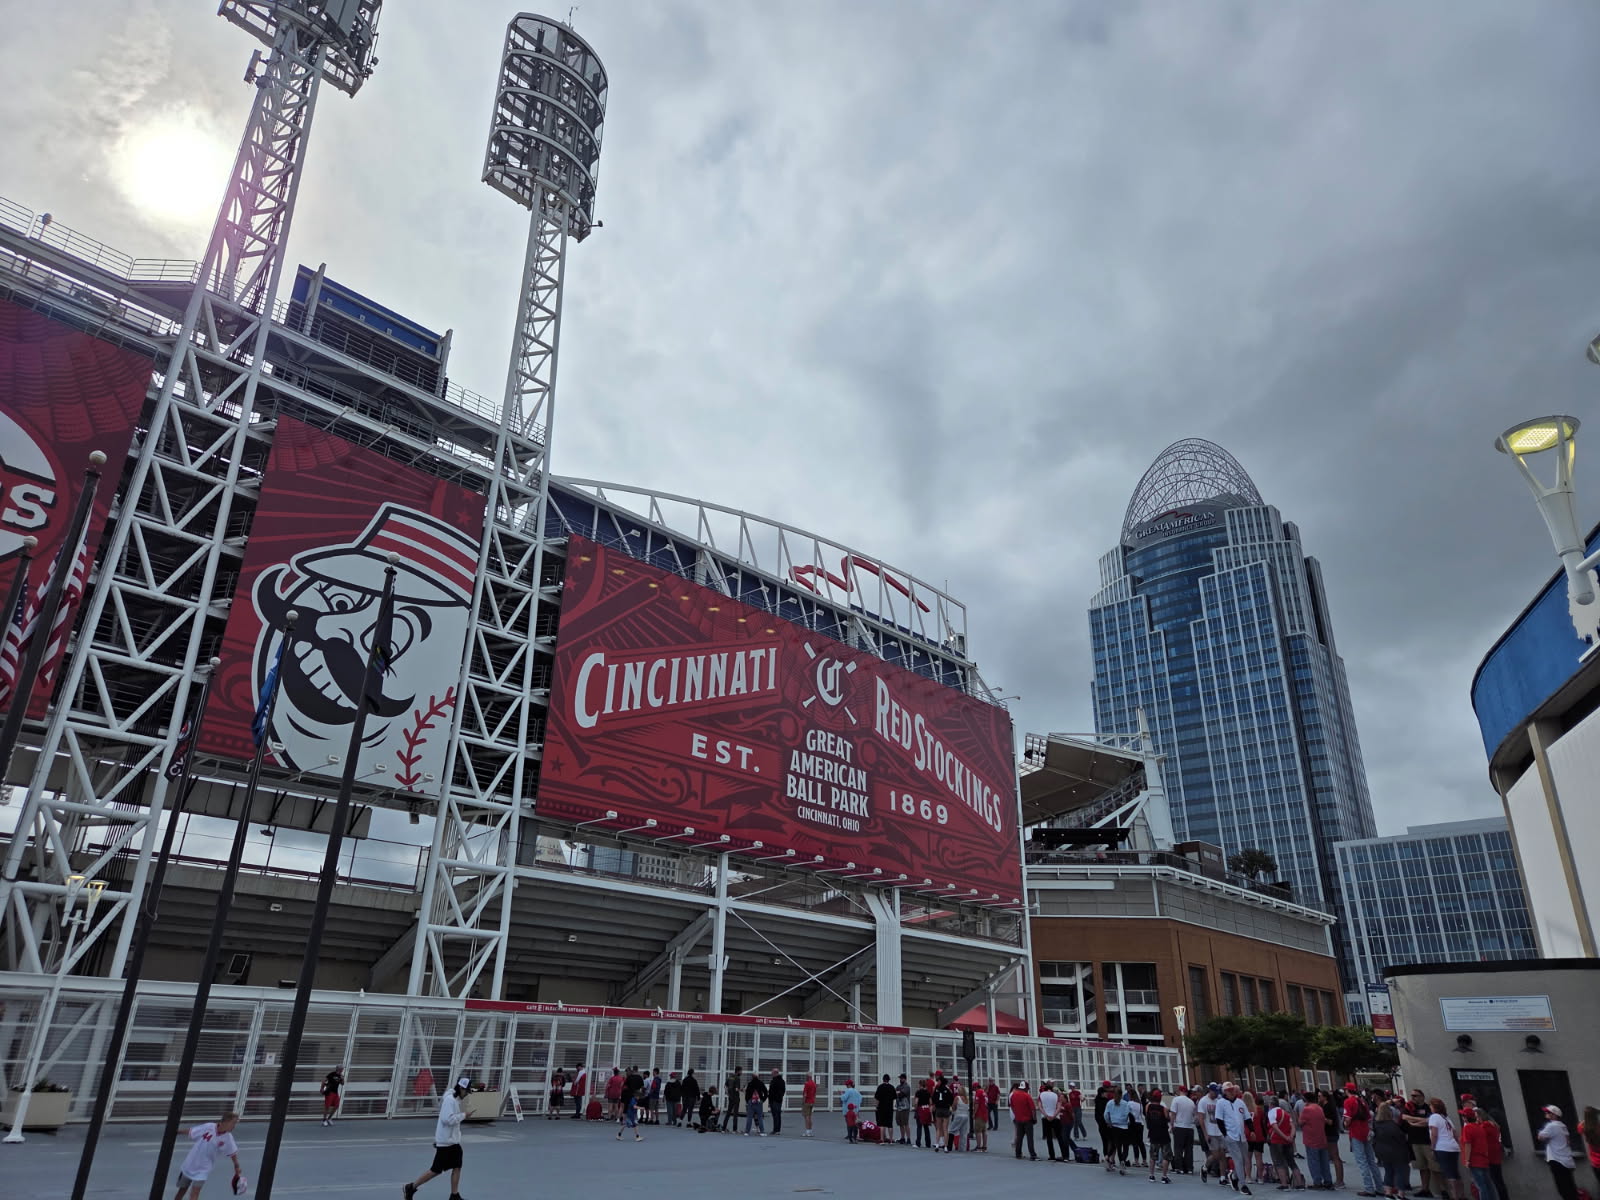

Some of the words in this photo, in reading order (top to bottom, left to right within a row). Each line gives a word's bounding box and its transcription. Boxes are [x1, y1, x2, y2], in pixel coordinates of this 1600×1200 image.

[1136, 520, 1167, 540] GREAT
[1163, 511, 1216, 532] AMERICAN
[575, 648, 778, 729] CINCINNATI
[691, 732, 761, 773] EST.
[806, 729, 854, 763] GREAT
[875, 675, 912, 751] RED
[914, 713, 1003, 833] STOCKINGS
[790, 749, 867, 793] AMERICAN
[786, 773, 826, 807] BALL
[831, 786, 870, 818] PARK
[889, 790, 949, 825] 1869
[797, 805, 842, 829] CINCINNATI,
[842, 817, 860, 832] OHIO
